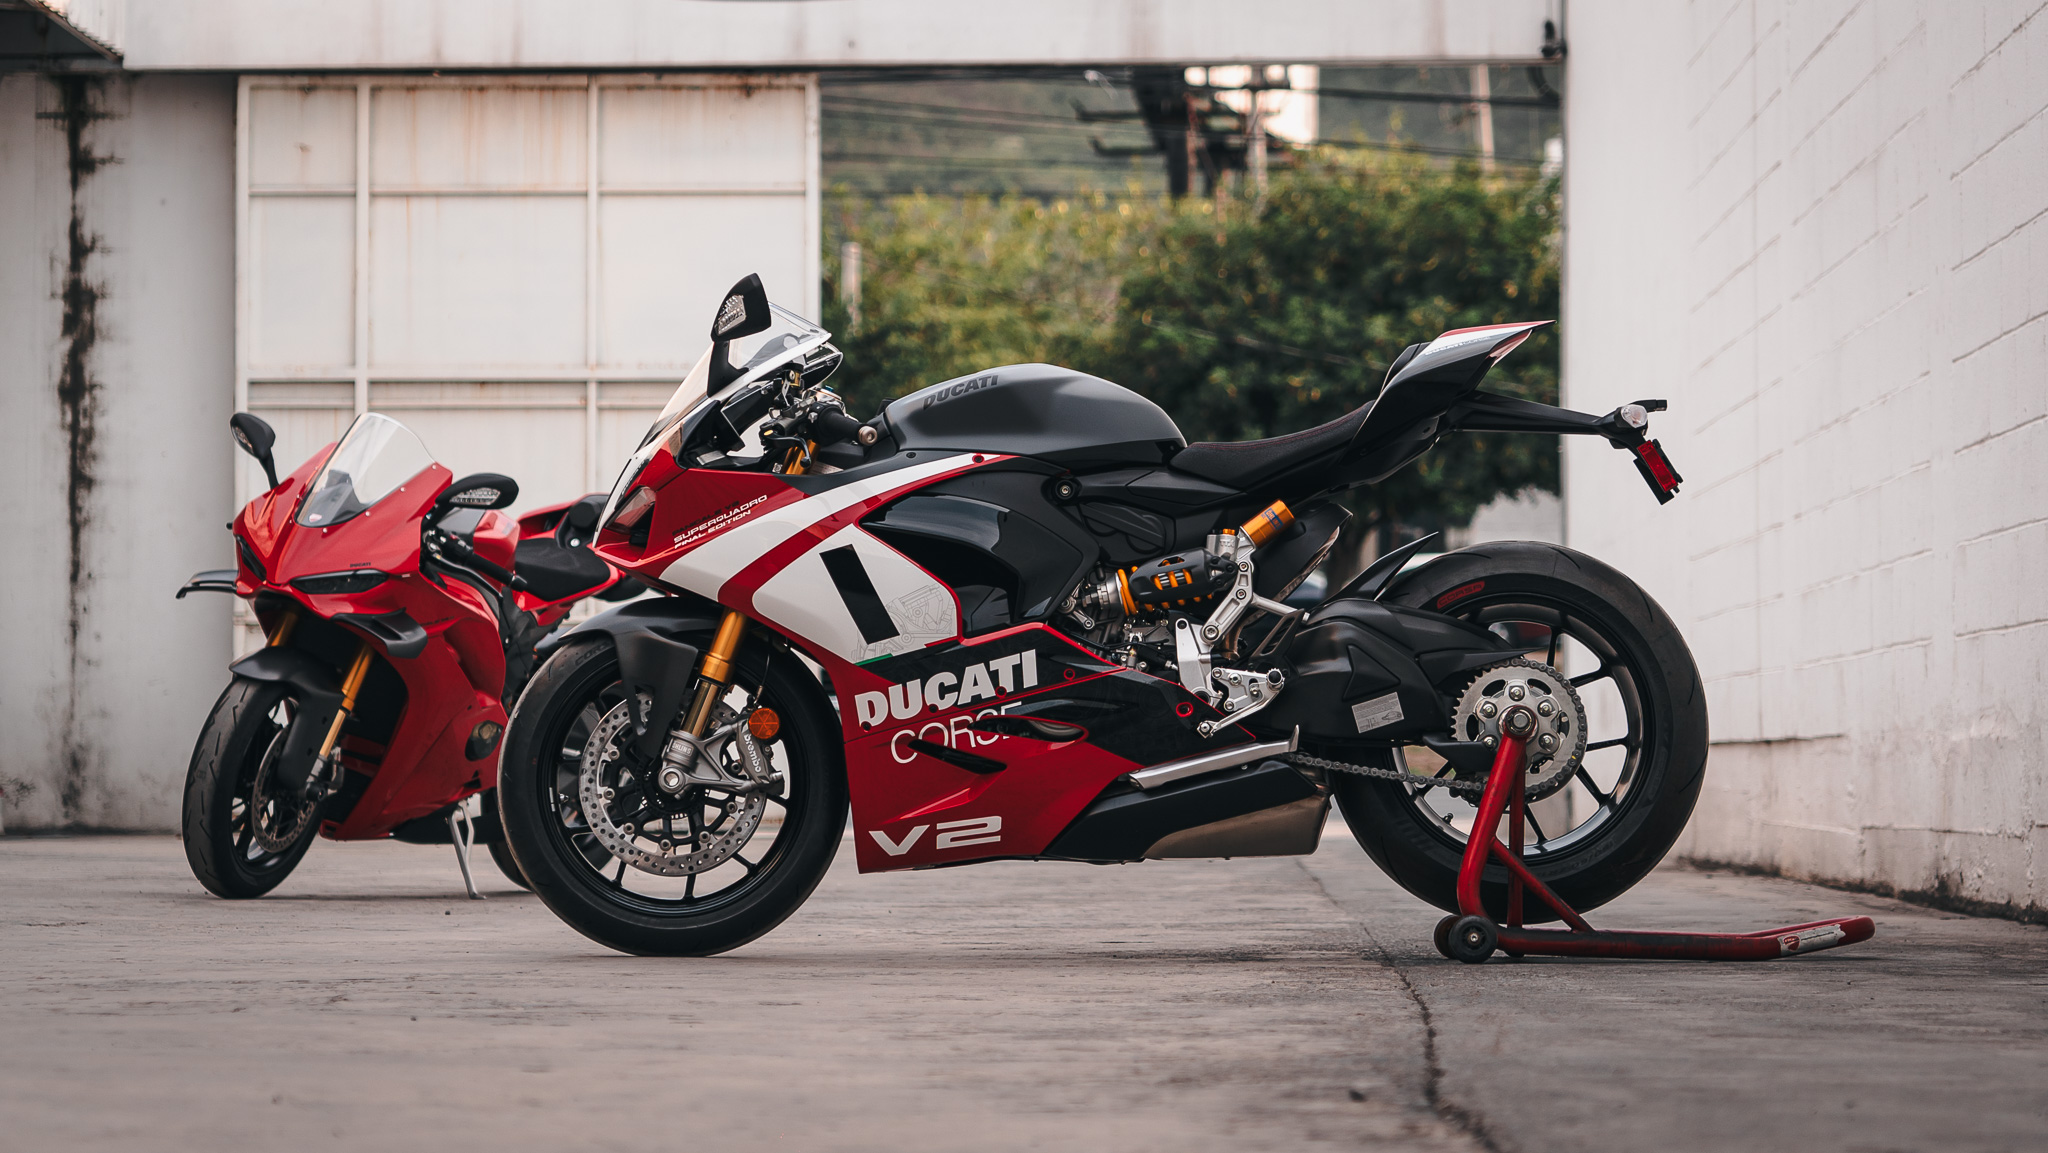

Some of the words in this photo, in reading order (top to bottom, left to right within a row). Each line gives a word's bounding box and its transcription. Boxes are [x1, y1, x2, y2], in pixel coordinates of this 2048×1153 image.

[923, 375, 999, 411] DUCATI
[673, 494, 768, 544] SUPERQUADRO
[674, 532, 708, 550] FINAL
[707, 509, 752, 534] EDITION
[1438, 583, 1482, 606] CORSA
[575, 640, 612, 667] CORS
[854, 648, 1039, 728] DUCATI
[743, 733, 762, 774] brembo
[868, 815, 1002, 857] V2
